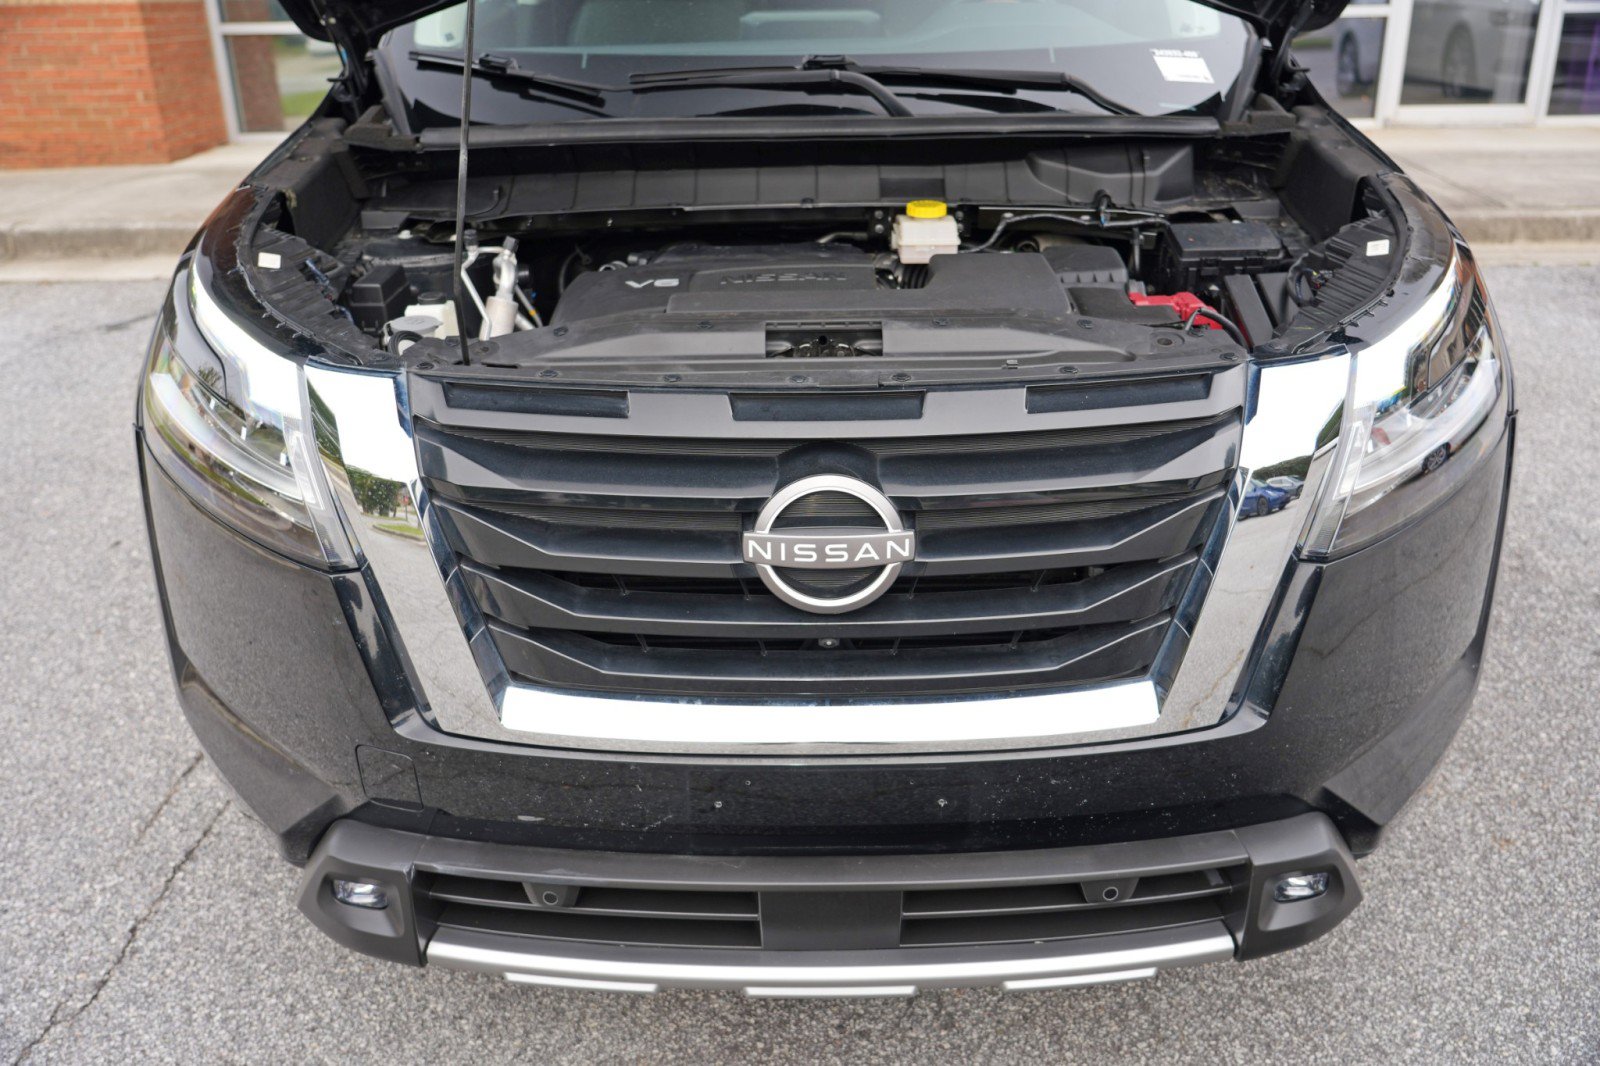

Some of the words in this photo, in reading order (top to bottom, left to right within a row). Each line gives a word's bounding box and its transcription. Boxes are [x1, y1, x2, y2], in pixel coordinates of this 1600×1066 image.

[625, 278, 679, 288] V6
[720, 272, 847, 285] NISSAN
[748, 538, 910, 562] NISSAN
